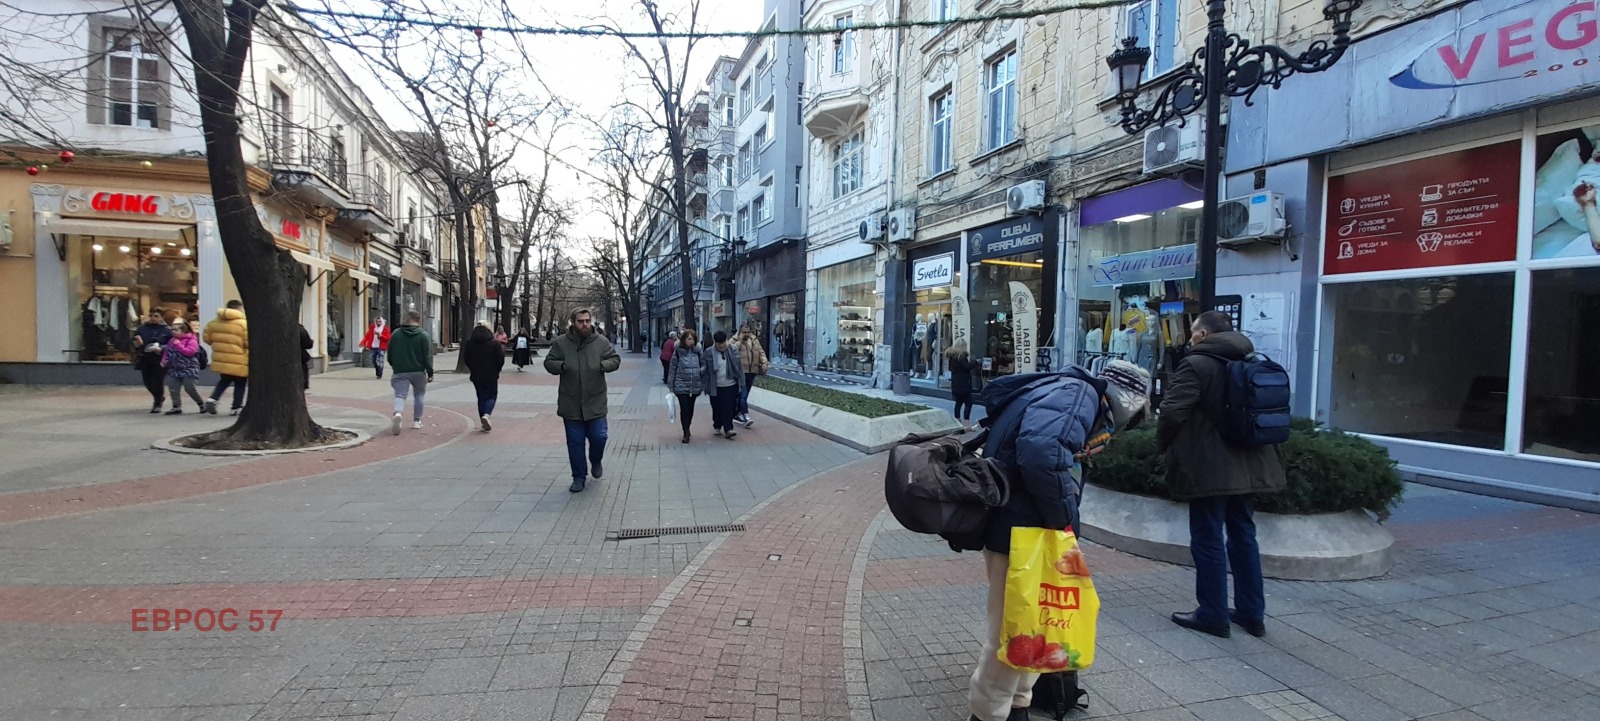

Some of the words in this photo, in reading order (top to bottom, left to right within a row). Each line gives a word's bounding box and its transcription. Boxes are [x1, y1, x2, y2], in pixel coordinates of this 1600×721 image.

[1437, 2, 1598, 81] VEG
[1523, 55, 1600, 78] 200
[1447, 177, 1490, 189] ПРОДУКТИ
[91, 191, 158, 215] GANG
[1359, 200, 1389, 209] КУХНЯТА
[1360, 195, 1382, 203] УРЕДИ
[1446, 203, 1499, 215] ХРАНИТЕЛНИ
[1358, 218, 1385, 227] СЪДОВЕ
[1445, 212, 1483, 222] ДОБАВКИ
[1001, 222, 1031, 238] DUBAI
[1358, 224, 1387, 233] ГОТВЕНЕ
[1444, 231, 1473, 239] МАСАЖ
[1443, 238, 1475, 246] РЕЛАКС
[917, 264, 949, 281] Svetla
[1039, 587, 1077, 606] BILLA
[1039, 607, 1073, 629] Card
